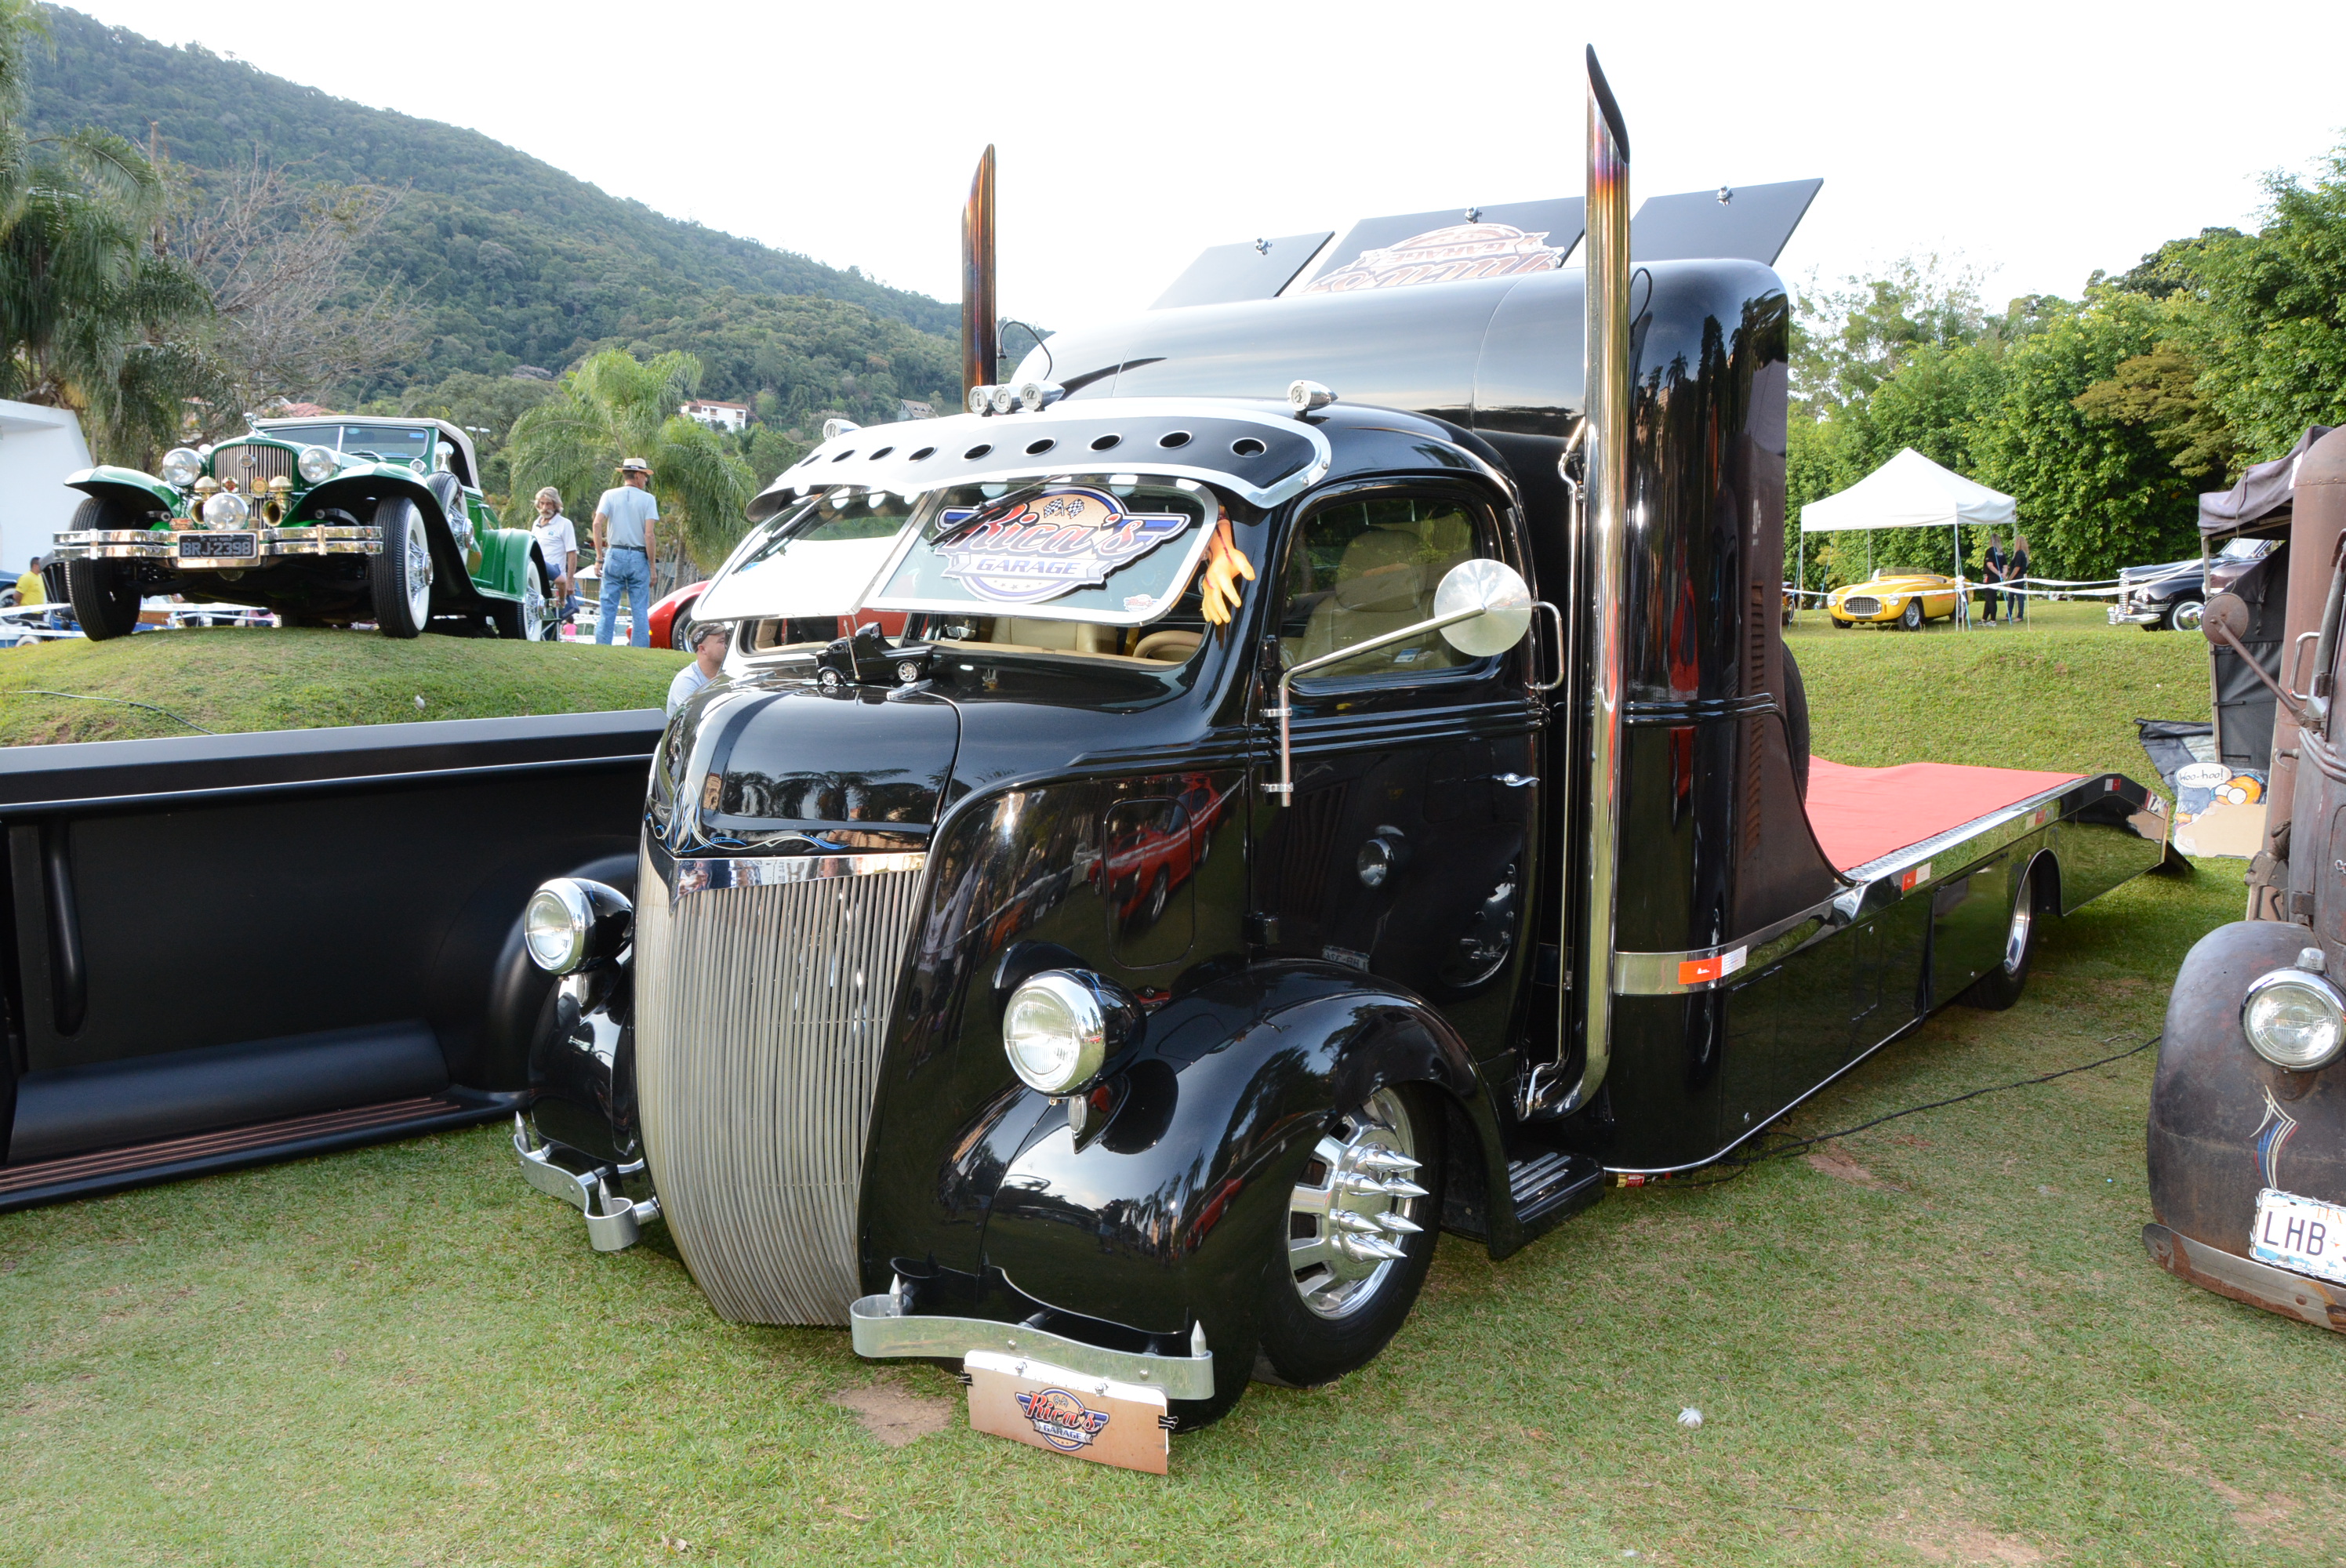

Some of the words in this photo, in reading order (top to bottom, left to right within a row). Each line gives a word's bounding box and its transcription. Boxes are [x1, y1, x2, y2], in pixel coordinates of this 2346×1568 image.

[1389, 241, 1505, 263] GARAGE
[945, 503, 1145, 554] Rica's
[181, 542, 251, 556] BRJ-2398
[976, 557, 1081, 575] GARAGE
[2179, 768, 2224, 781] Woo-hoo!
[1023, 1392, 1100, 1432] Rica's
[1043, 1424, 1082, 1440] GARAGE
